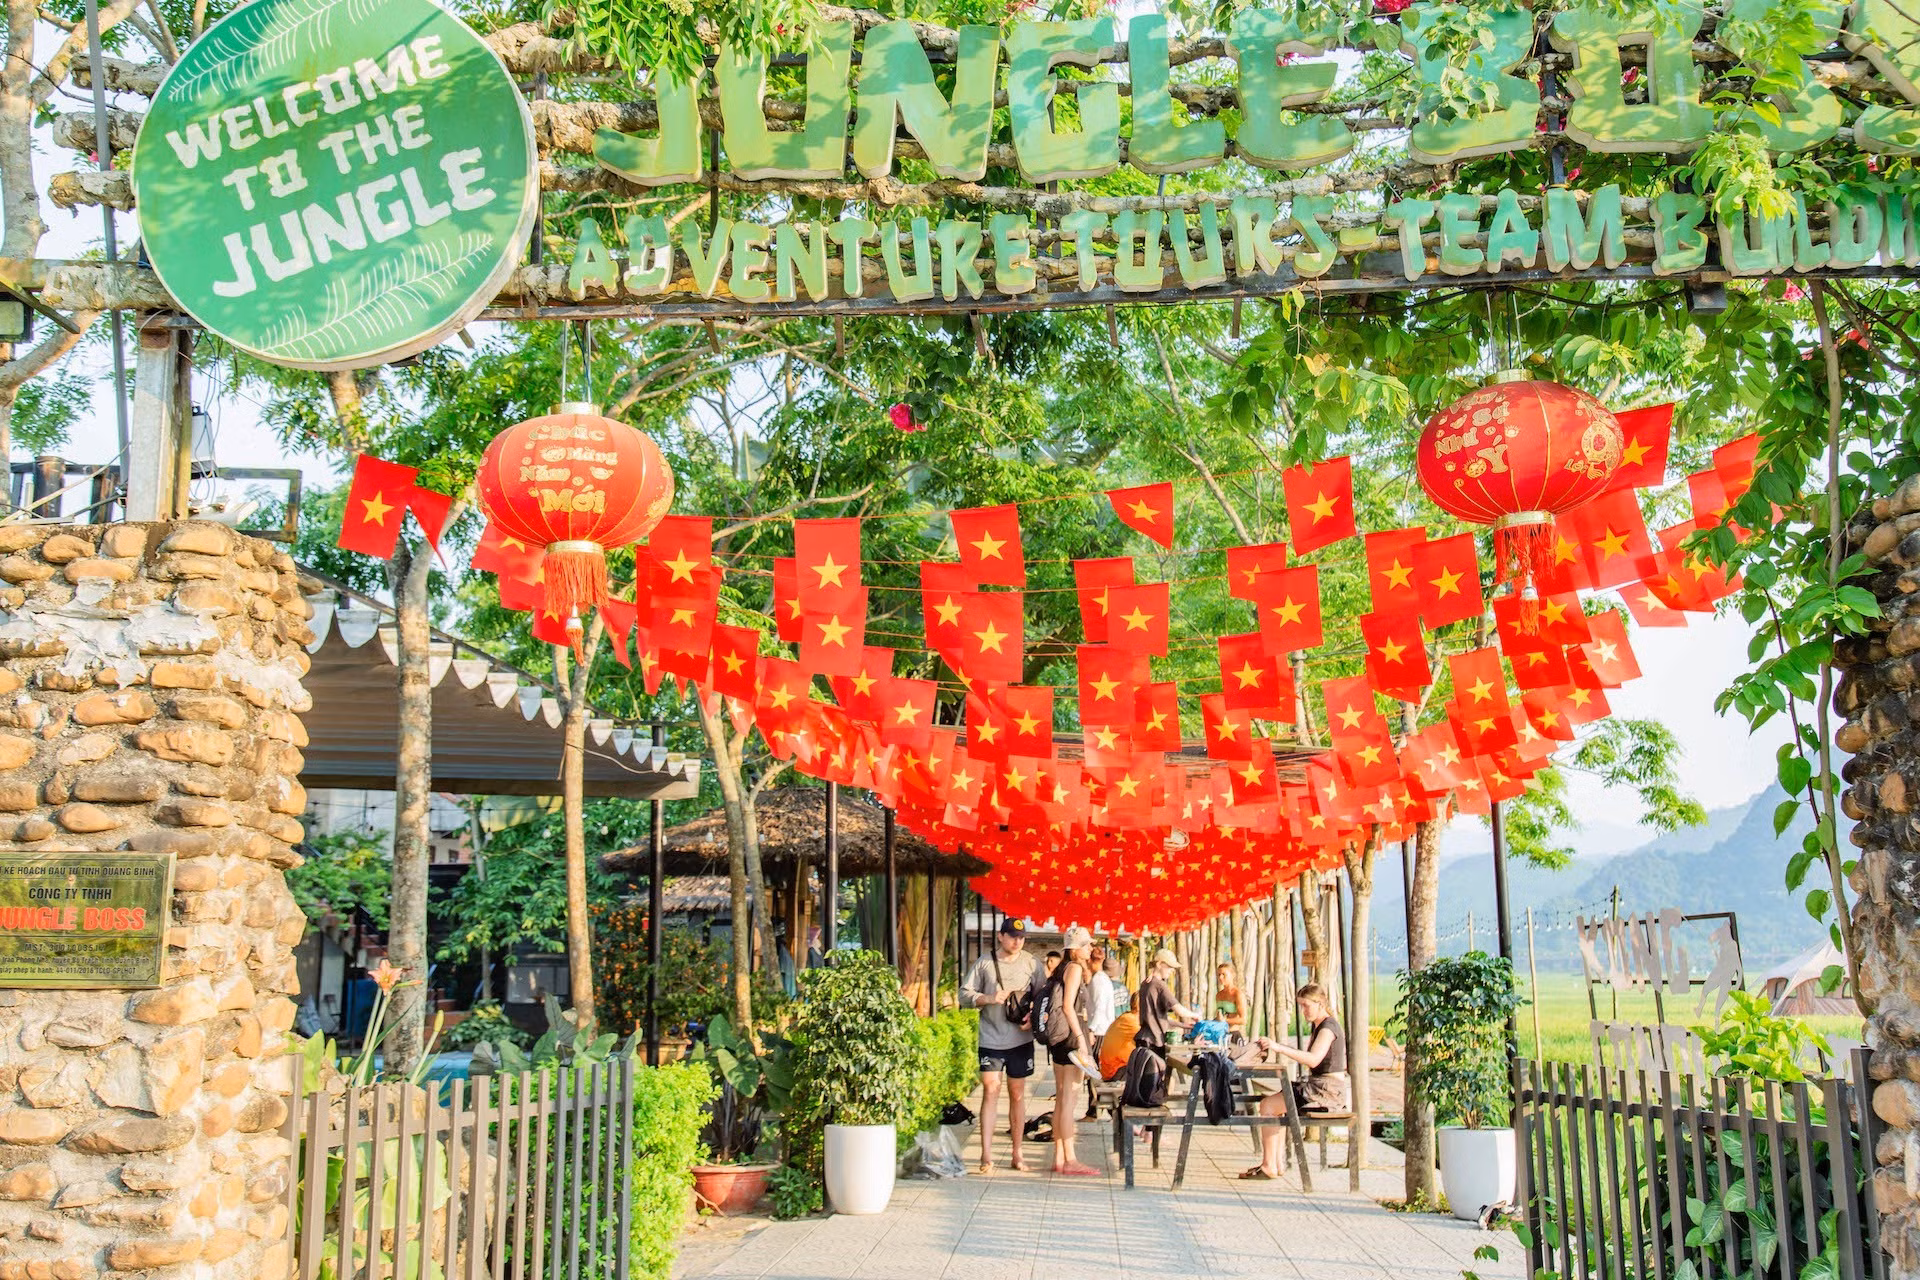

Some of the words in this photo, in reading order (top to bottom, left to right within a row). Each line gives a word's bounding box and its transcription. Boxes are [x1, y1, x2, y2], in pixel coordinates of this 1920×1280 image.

[165, 35, 451, 169] WELCOME
[592, 8, 1354, 185] JUNGLE
[222, 151, 304, 212] TO
[317, 104, 433, 177] THE
[211, 146, 497, 298] JUNGLE
[567, 211, 1037, 304] ADVENTURE
[1060, 195, 1338, 293] TOURS
[1384, 183, 1629, 282] TEAM
[64, 887, 78, 900] TY
[82, 887, 113, 900] TNHH
[83, 906, 147, 931] BOSS
